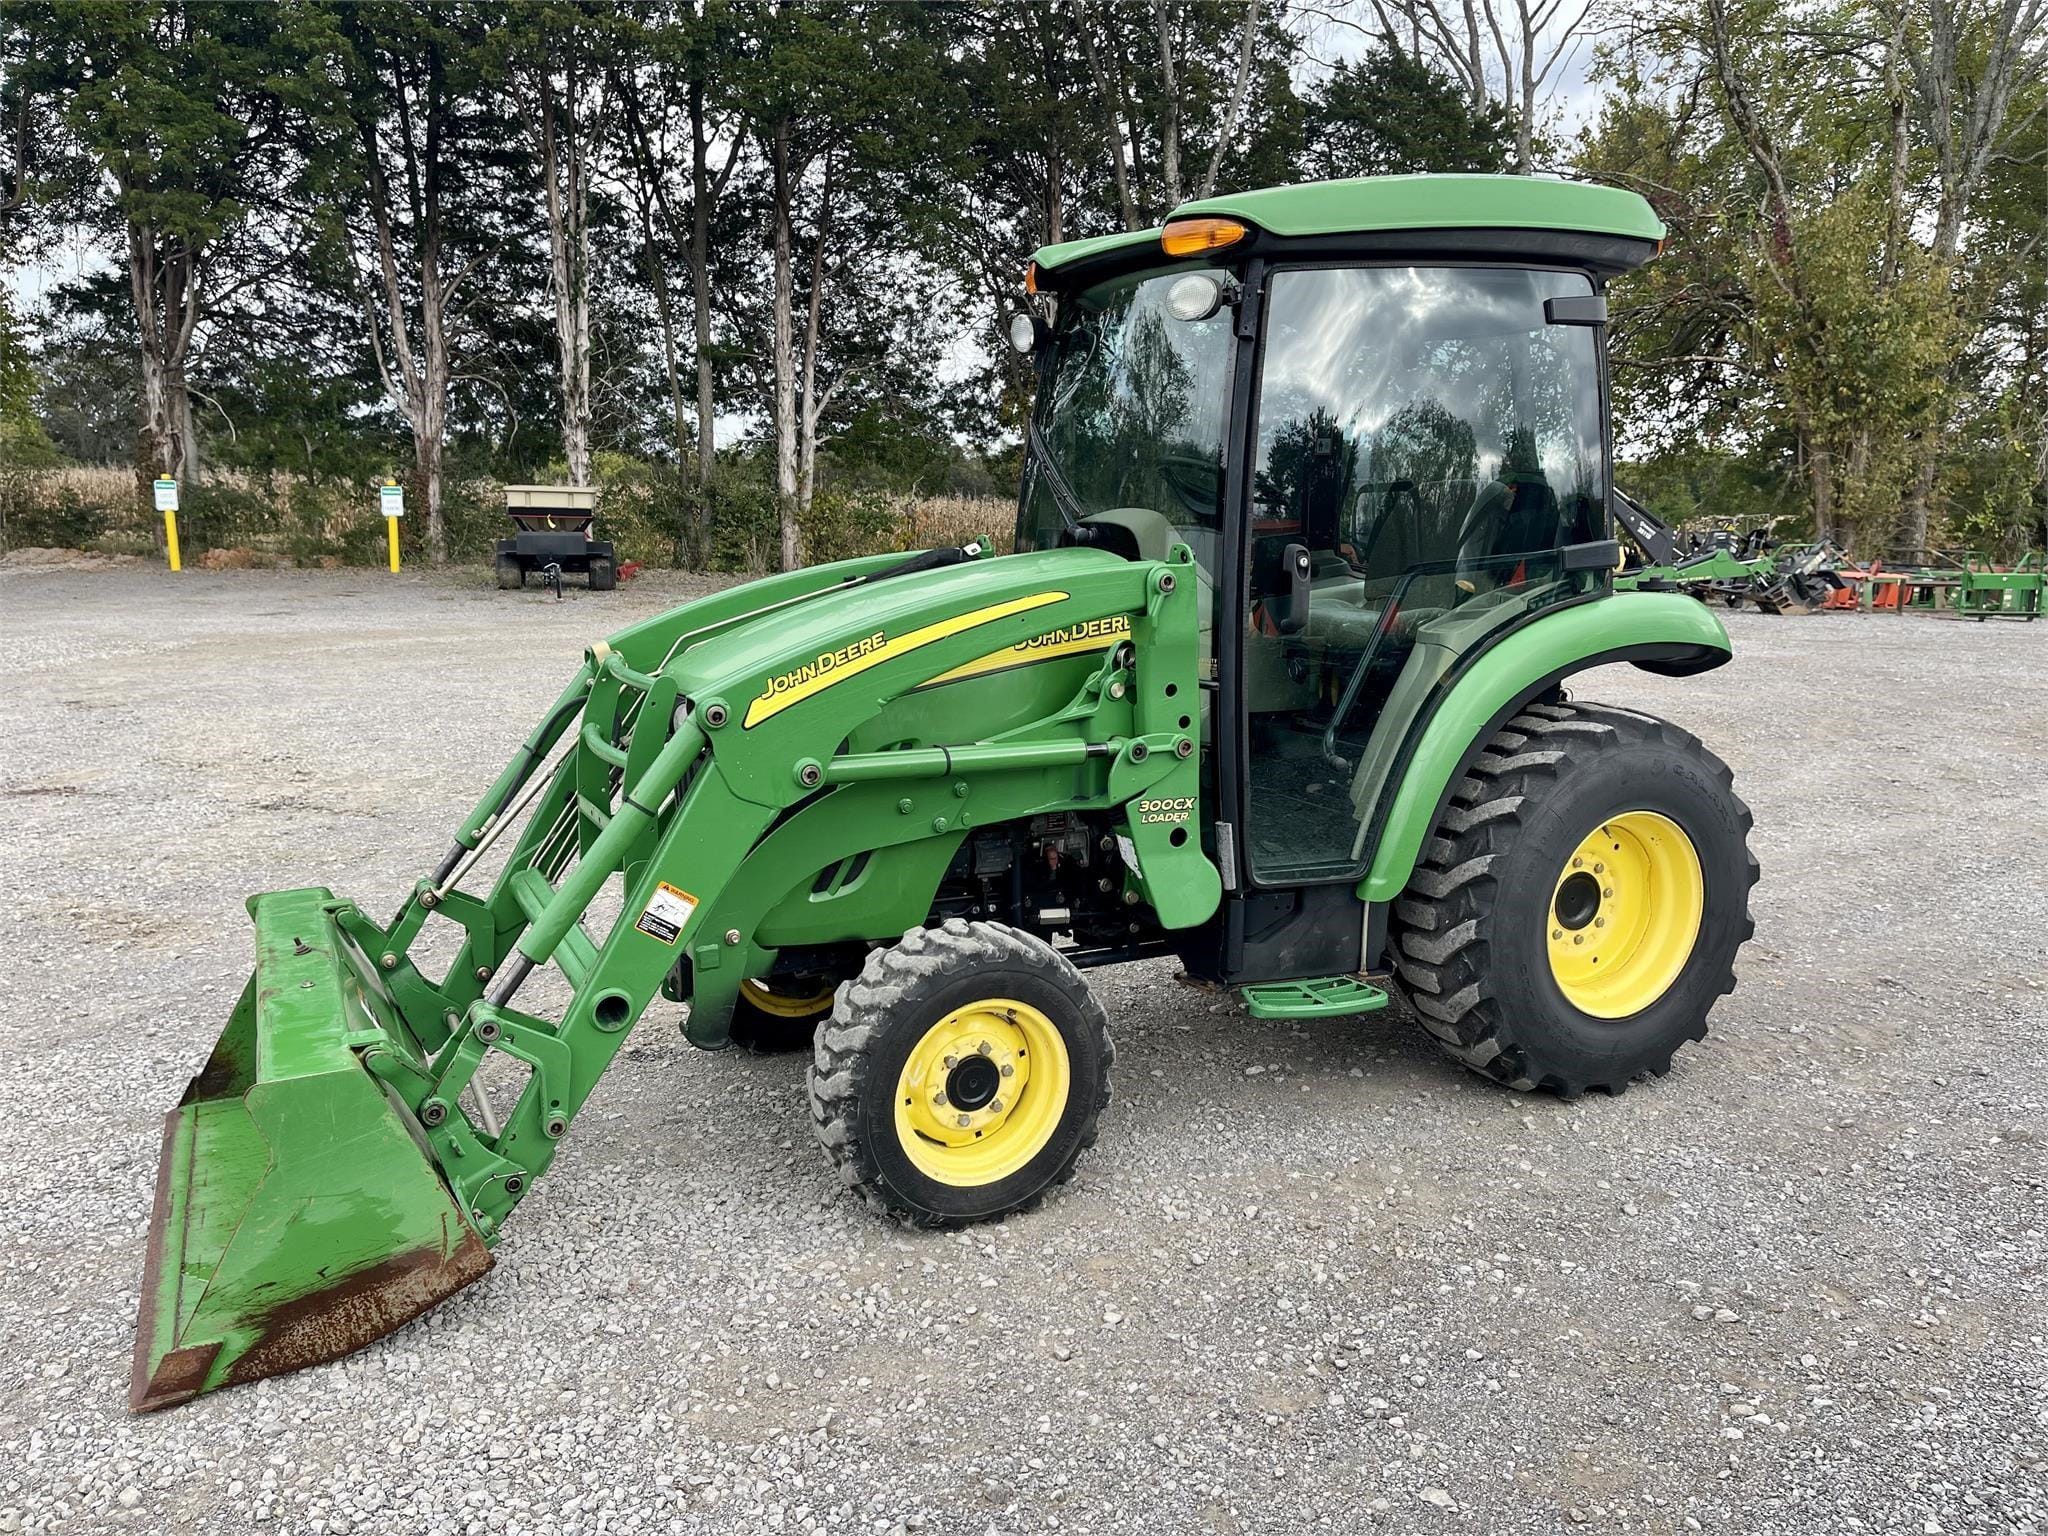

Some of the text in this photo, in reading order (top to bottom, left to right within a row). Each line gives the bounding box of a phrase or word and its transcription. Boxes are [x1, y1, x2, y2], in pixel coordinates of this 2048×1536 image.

[761, 630, 886, 700] JOHN DEERE
[1138, 797, 1197, 813] 300CX
[1141, 811, 1189, 824] LOADER
